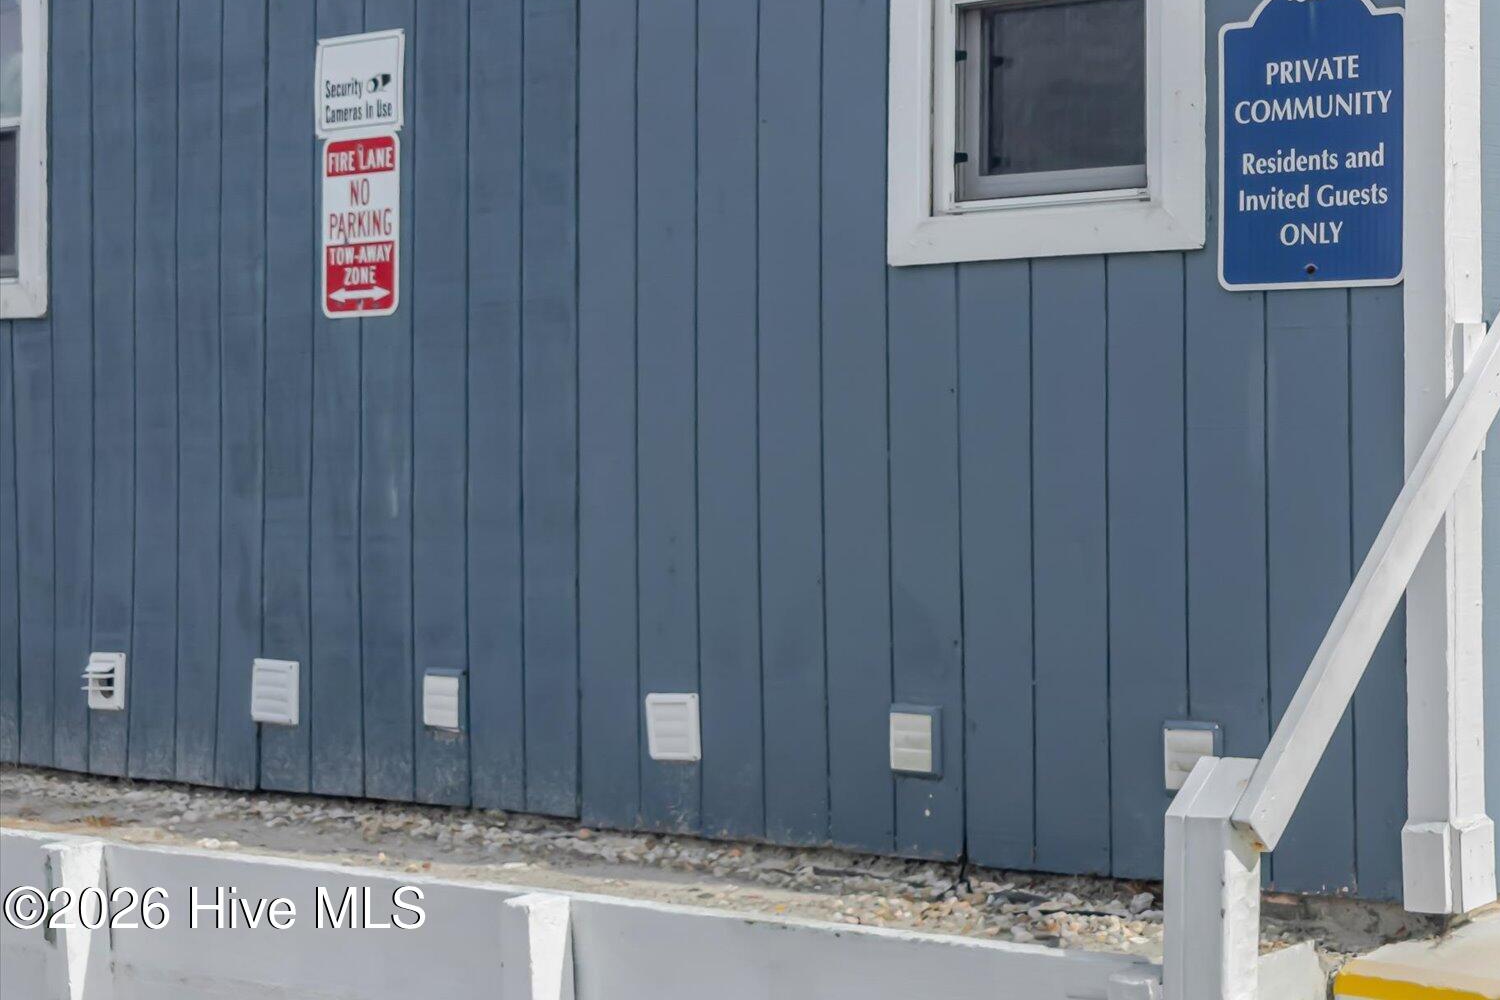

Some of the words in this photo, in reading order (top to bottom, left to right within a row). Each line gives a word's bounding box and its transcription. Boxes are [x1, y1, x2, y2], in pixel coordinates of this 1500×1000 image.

[1266, 55, 1359, 85] PRIVATE
[325, 78, 364, 99] Security
[325, 104, 363, 123] Cameras
[365, 101, 374, 119] In
[376, 98, 392, 118] Use
[1234, 89, 1392, 125] COMMUNITY
[328, 151, 356, 174] FIRE
[359, 146, 394, 171] LANE
[1242, 147, 1338, 175] Residents
[1345, 142, 1384, 169] and
[350, 178, 370, 206] NO
[1239, 184, 1309, 211] Invited
[1317, 183, 1388, 207] Guests
[329, 208, 392, 240] PARKING
[1279, 221, 1343, 247] ONLY
[330, 244, 391, 266] TOW-AWAY
[344, 267, 376, 286] ZONE
